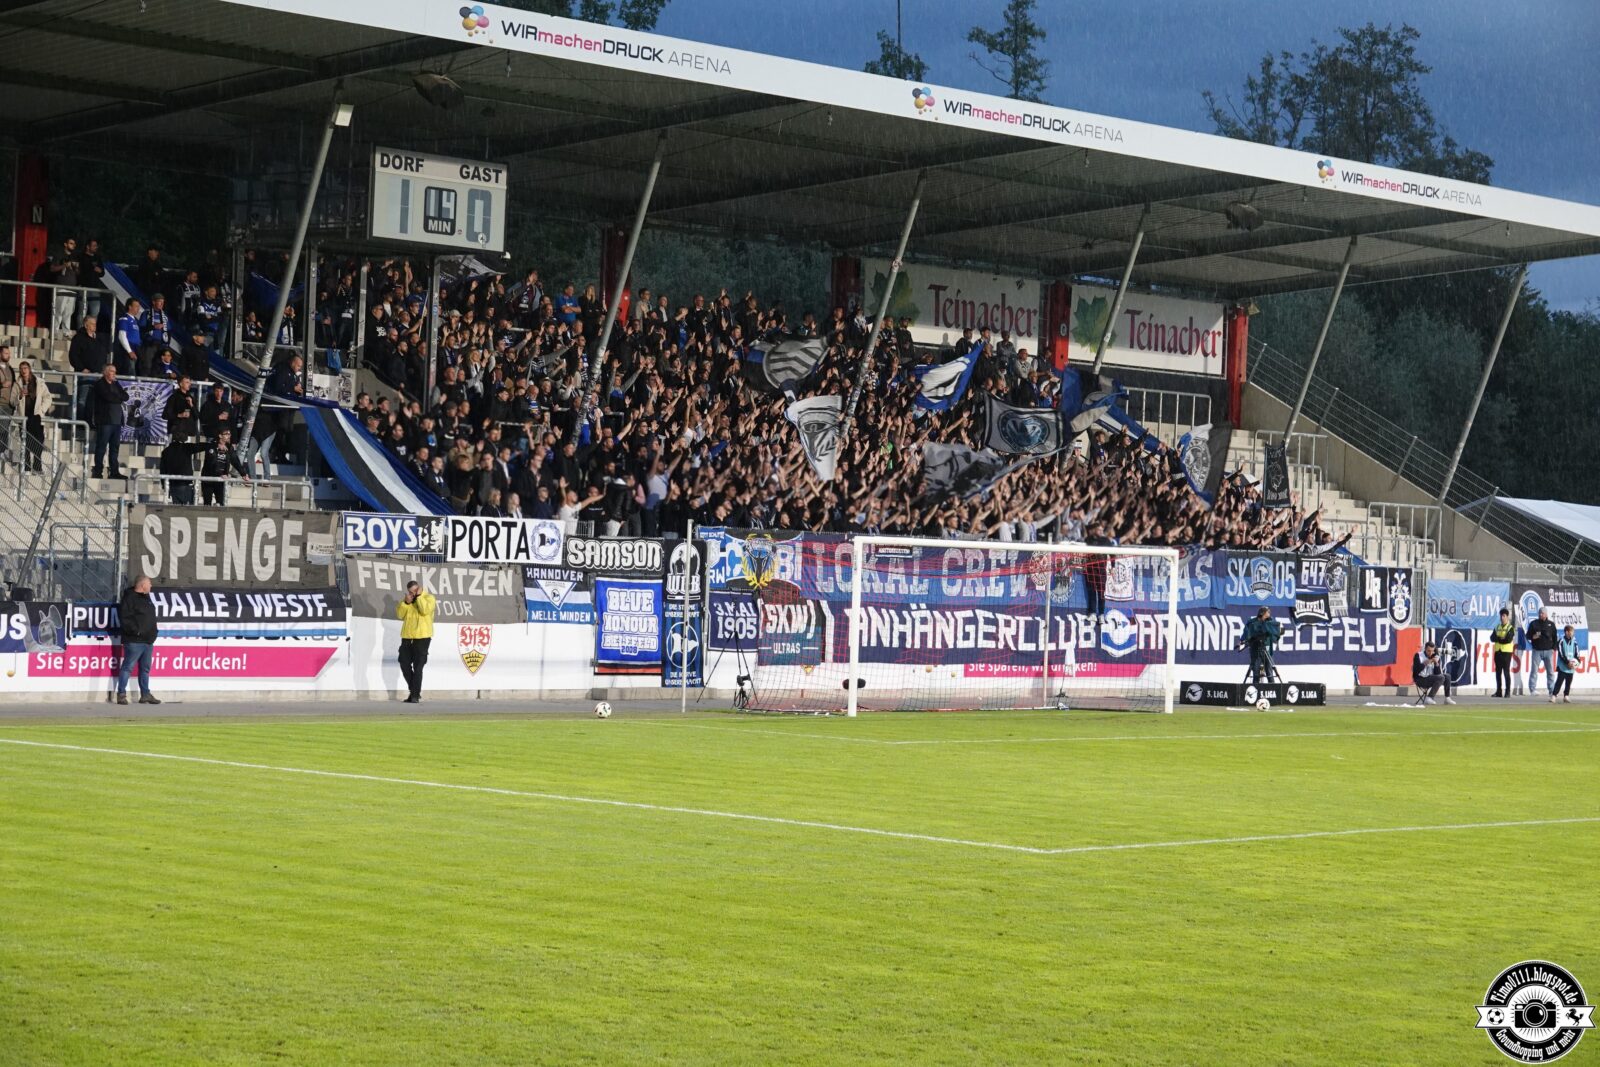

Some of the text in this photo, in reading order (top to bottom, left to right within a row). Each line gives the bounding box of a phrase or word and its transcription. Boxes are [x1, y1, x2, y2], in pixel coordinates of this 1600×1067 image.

[501, 20, 732, 74] WIRmachenDRUCK ARENA
[943, 99, 1124, 143] WIRmachenDRUCK ARENA
[380, 152, 424, 173] DORF
[459, 164, 502, 184] GAST
[1341, 169, 1482, 206] WIRmachenDRUCK ARENA
[427, 219, 451, 233] MIN
[928, 283, 1038, 339] Teinacher
[1124, 308, 1222, 358] Teinacher
[142, 513, 304, 582] SPENGE
[346, 517, 418, 551] BOYS
[451, 519, 531, 561] PORTA
[567, 538, 663, 571] SAMSON
[812, 542, 929, 595] LOKAL
[941, 547, 1029, 598] CREW
[356, 560, 514, 597] FETTKATZEN
[526, 567, 583, 582] HANNOVER
[1225, 557, 1296, 600] SK 05
[149, 592, 230, 618] HALLE
[246, 593, 333, 618] WESTF.
[435, 600, 474, 617] TOUR
[531, 610, 591, 622] MELLE MINDEN
[607, 589, 654, 612] BLUE
[717, 616, 758, 640] 1905
[843, 603, 1098, 651] ANHÄNGERCLUB
[36, 652, 64, 670] Sie
[172, 652, 248, 671] drucken!
[774, 642, 801, 654] ULTRAS
[1213, 691, 1229, 699] LIGA
